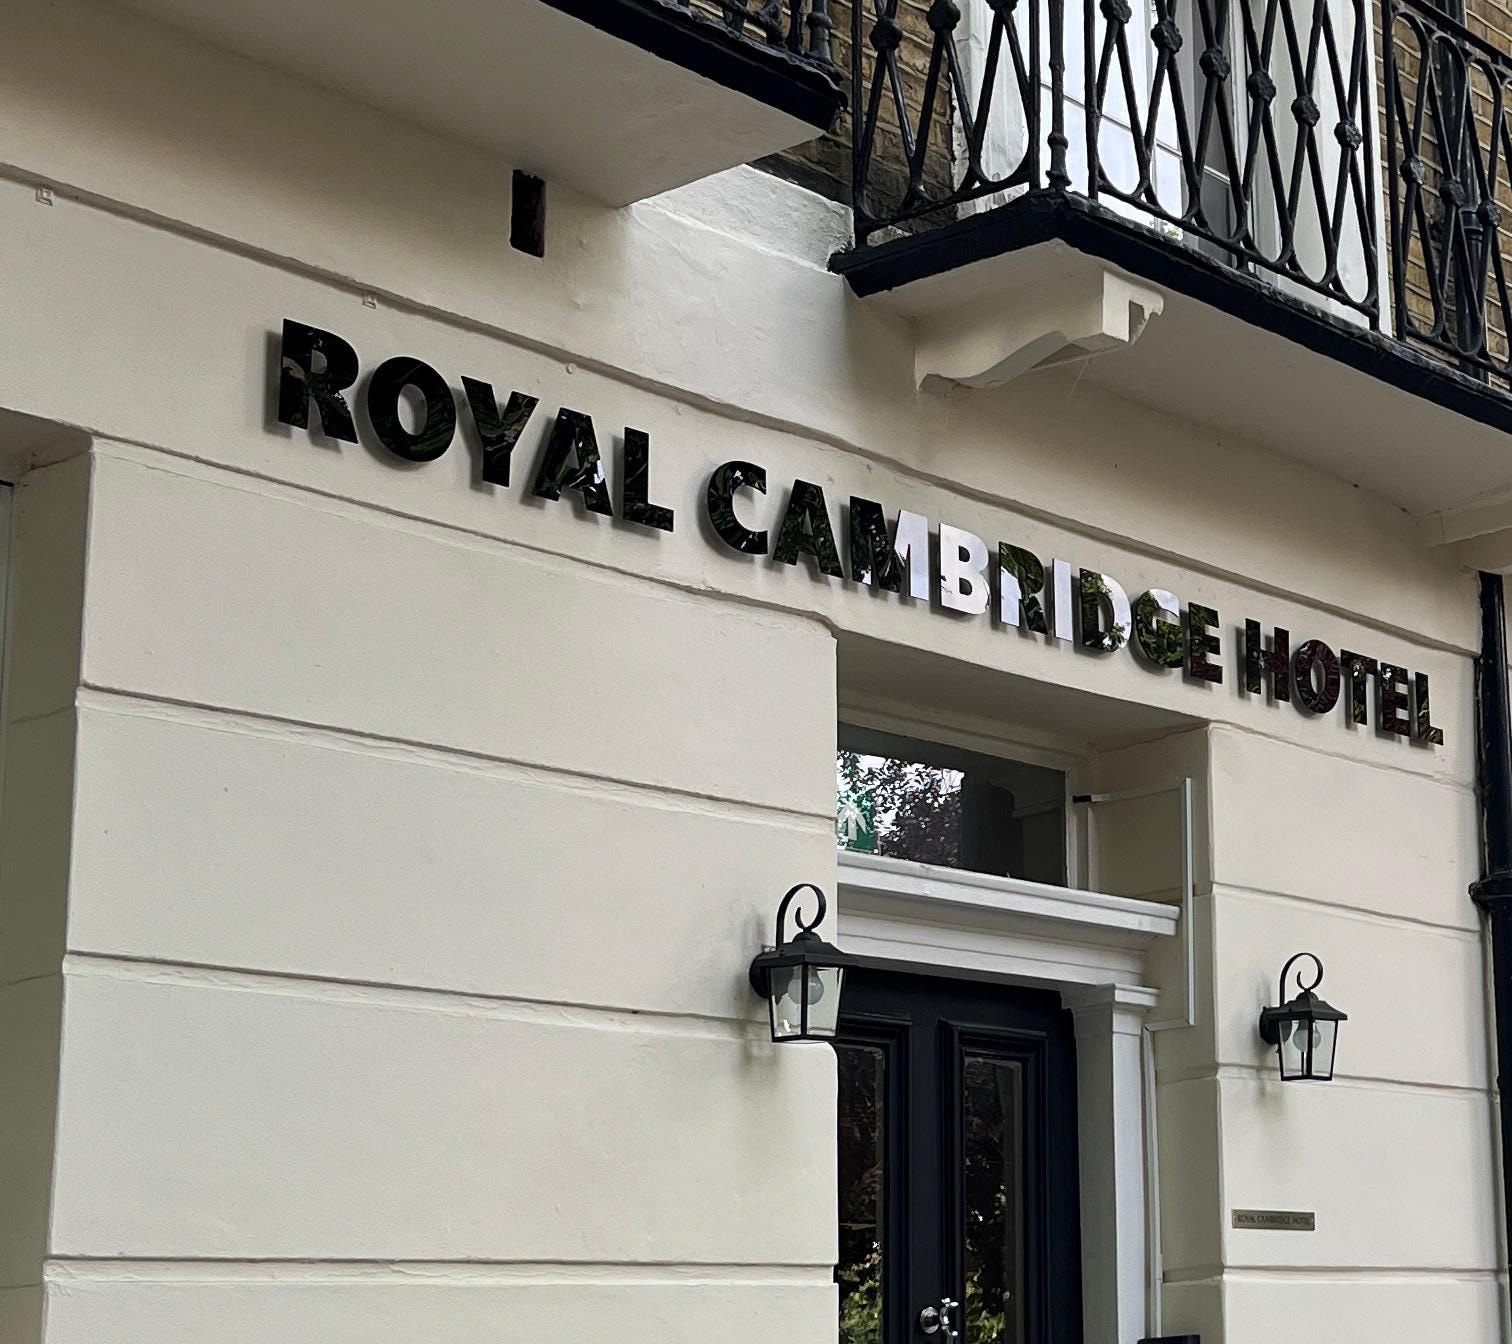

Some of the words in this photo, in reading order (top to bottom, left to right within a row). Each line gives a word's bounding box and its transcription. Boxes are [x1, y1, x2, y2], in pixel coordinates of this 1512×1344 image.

[278, 318, 674, 532] ROYAL
[706, 460, 1223, 684] CAMBRIDGE
[1245, 617, 1444, 746] HOTEL
